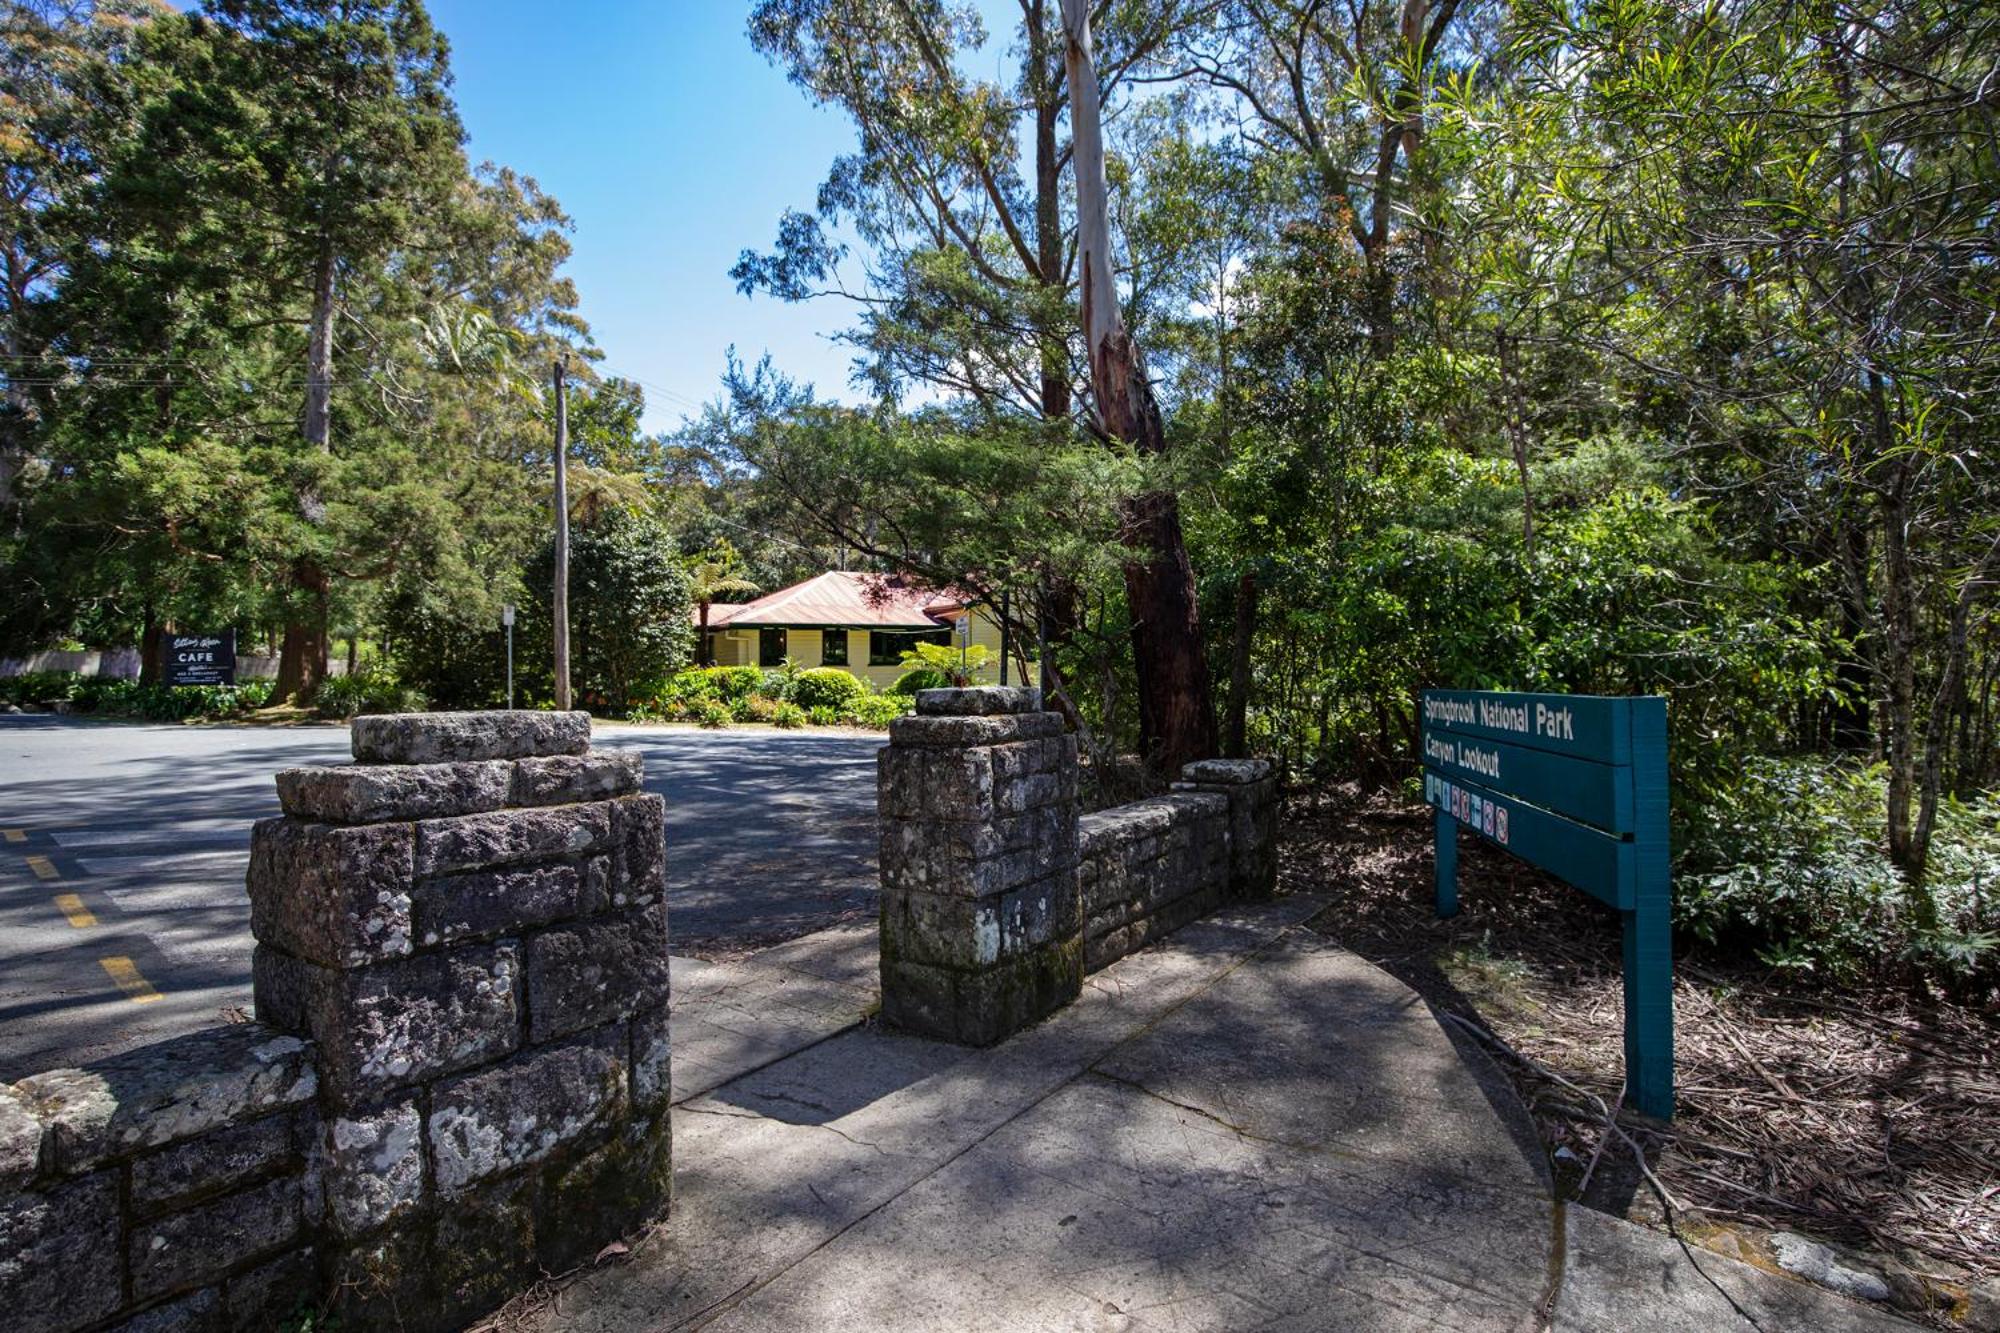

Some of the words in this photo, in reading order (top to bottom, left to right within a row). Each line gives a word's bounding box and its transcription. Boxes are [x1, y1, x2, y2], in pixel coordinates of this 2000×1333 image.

[178, 652, 213, 662] CAFE
[1425, 695, 1476, 727] Springbrook
[1480, 699, 1529, 733] National
[1536, 702, 1574, 740] Park
[1425, 732, 1455, 766] Canyon
[1458, 741, 1500, 779] Lookout
